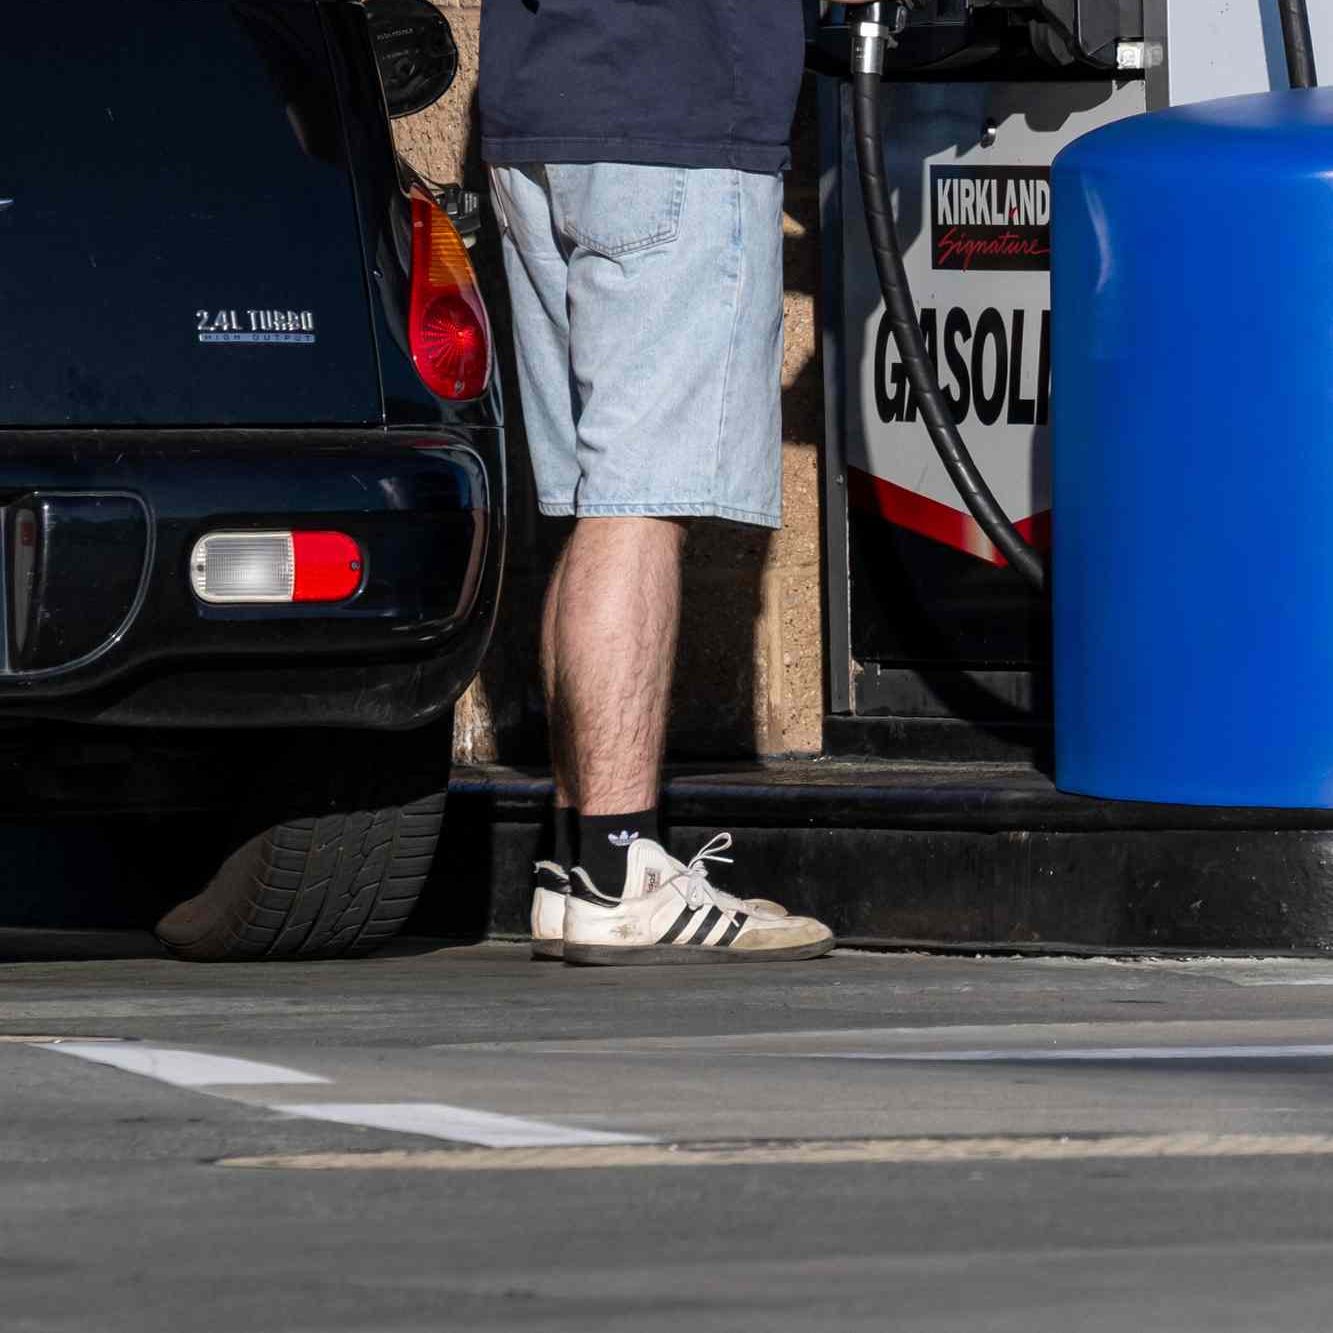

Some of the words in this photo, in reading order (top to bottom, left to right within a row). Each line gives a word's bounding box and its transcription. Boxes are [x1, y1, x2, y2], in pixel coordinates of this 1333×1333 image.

[937, 178, 1050, 225] KIRKLAND
[938, 226, 1050, 272] Signature
[195, 309, 243, 331] 2.4L
[247, 310, 314, 331] TURBO
